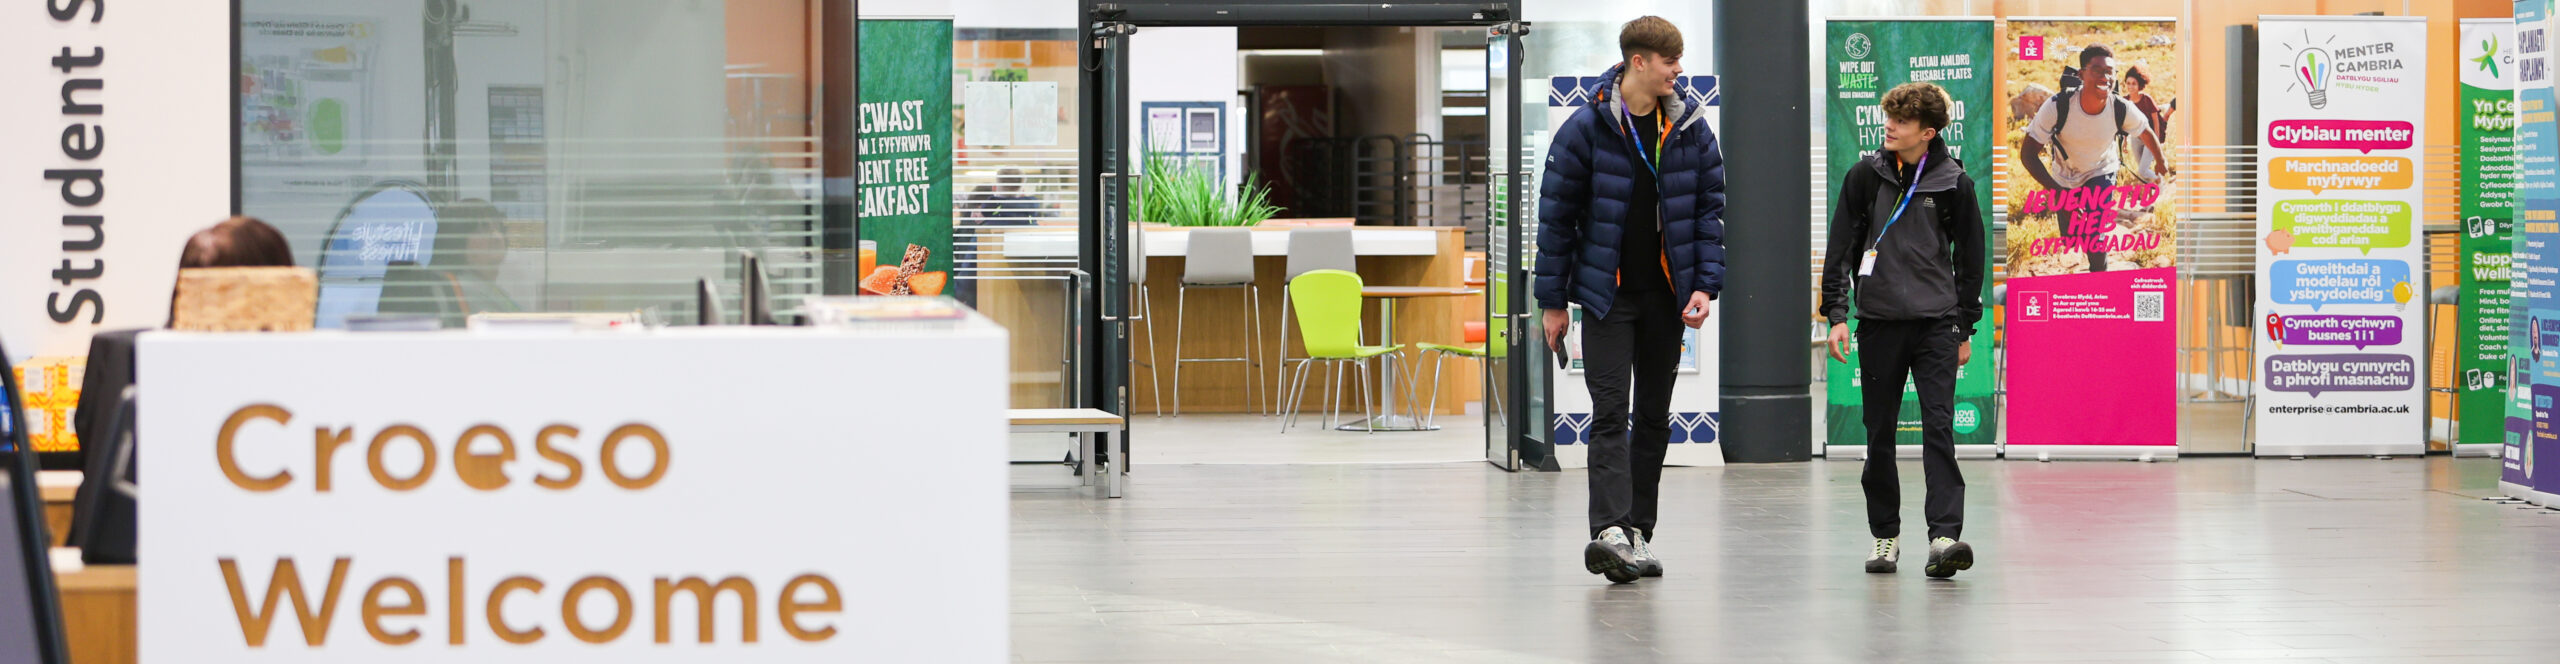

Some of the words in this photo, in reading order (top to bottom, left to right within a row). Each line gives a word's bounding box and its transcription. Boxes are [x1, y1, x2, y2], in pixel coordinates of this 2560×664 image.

[2335, 42, 2394, 60] MENTER
[1839, 61, 1859, 73] WIPE
[1860, 61, 1875, 73] OUT
[1910, 56, 1938, 68] PLATIAU
[1940, 54, 1970, 67] AMLDRO
[2336, 59, 2403, 73] CAMBRIA
[1910, 69, 1945, 82] REUSABLE
[1947, 67, 1972, 80] PLATES
[2336, 74, 2371, 82] DATBLYGU
[2473, 100, 2494, 112] Yn
[858, 100, 924, 134] CWAST
[2272, 125, 2342, 144] Clybiau
[2345, 127, 2411, 142] menter
[879, 134, 931, 154] FYFYRWYR
[895, 157, 929, 182] FREE
[2285, 160, 2398, 173] Marchnadoedd
[44, 46, 105, 325] Student
[2307, 174, 2382, 189] myfyrwyr
[2023, 182, 2160, 214] IEUENCTID
[2281, 202, 2332, 214] Cymorth
[2341, 202, 2402, 215] ddatblygu
[2067, 209, 2119, 235] HEB
[2294, 213, 2378, 225] digwyddiadau
[2380, 215, 2387, 223] a
[2293, 224, 2389, 236] gweithgareddau
[2312, 235, 2337, 245] codi
[2339, 235, 2370, 245] arian
[2296, 263, 2368, 275] Gweithdai
[2372, 265, 2380, 275] a
[2296, 276, 2359, 287] modelau
[2361, 275, 2381, 287] rôl
[2290, 287, 2383, 302] ysbrydoledig
[2285, 317, 2339, 331] Cymorth
[2340, 318, 2395, 331] cychwyn
[2308, 331, 2352, 341] busnes
[2354, 331, 2359, 341] 1
[2369, 331, 2374, 341] 1
[2272, 360, 2339, 374] Datblygu
[2342, 360, 2410, 374] cynnyrch
[2273, 375, 2282, 386] a
[2286, 373, 2331, 388] phrofi
[2334, 373, 2409, 386] masnachu
[215, 401, 671, 493] Croeso
[216, 555, 844, 648] Welcome
